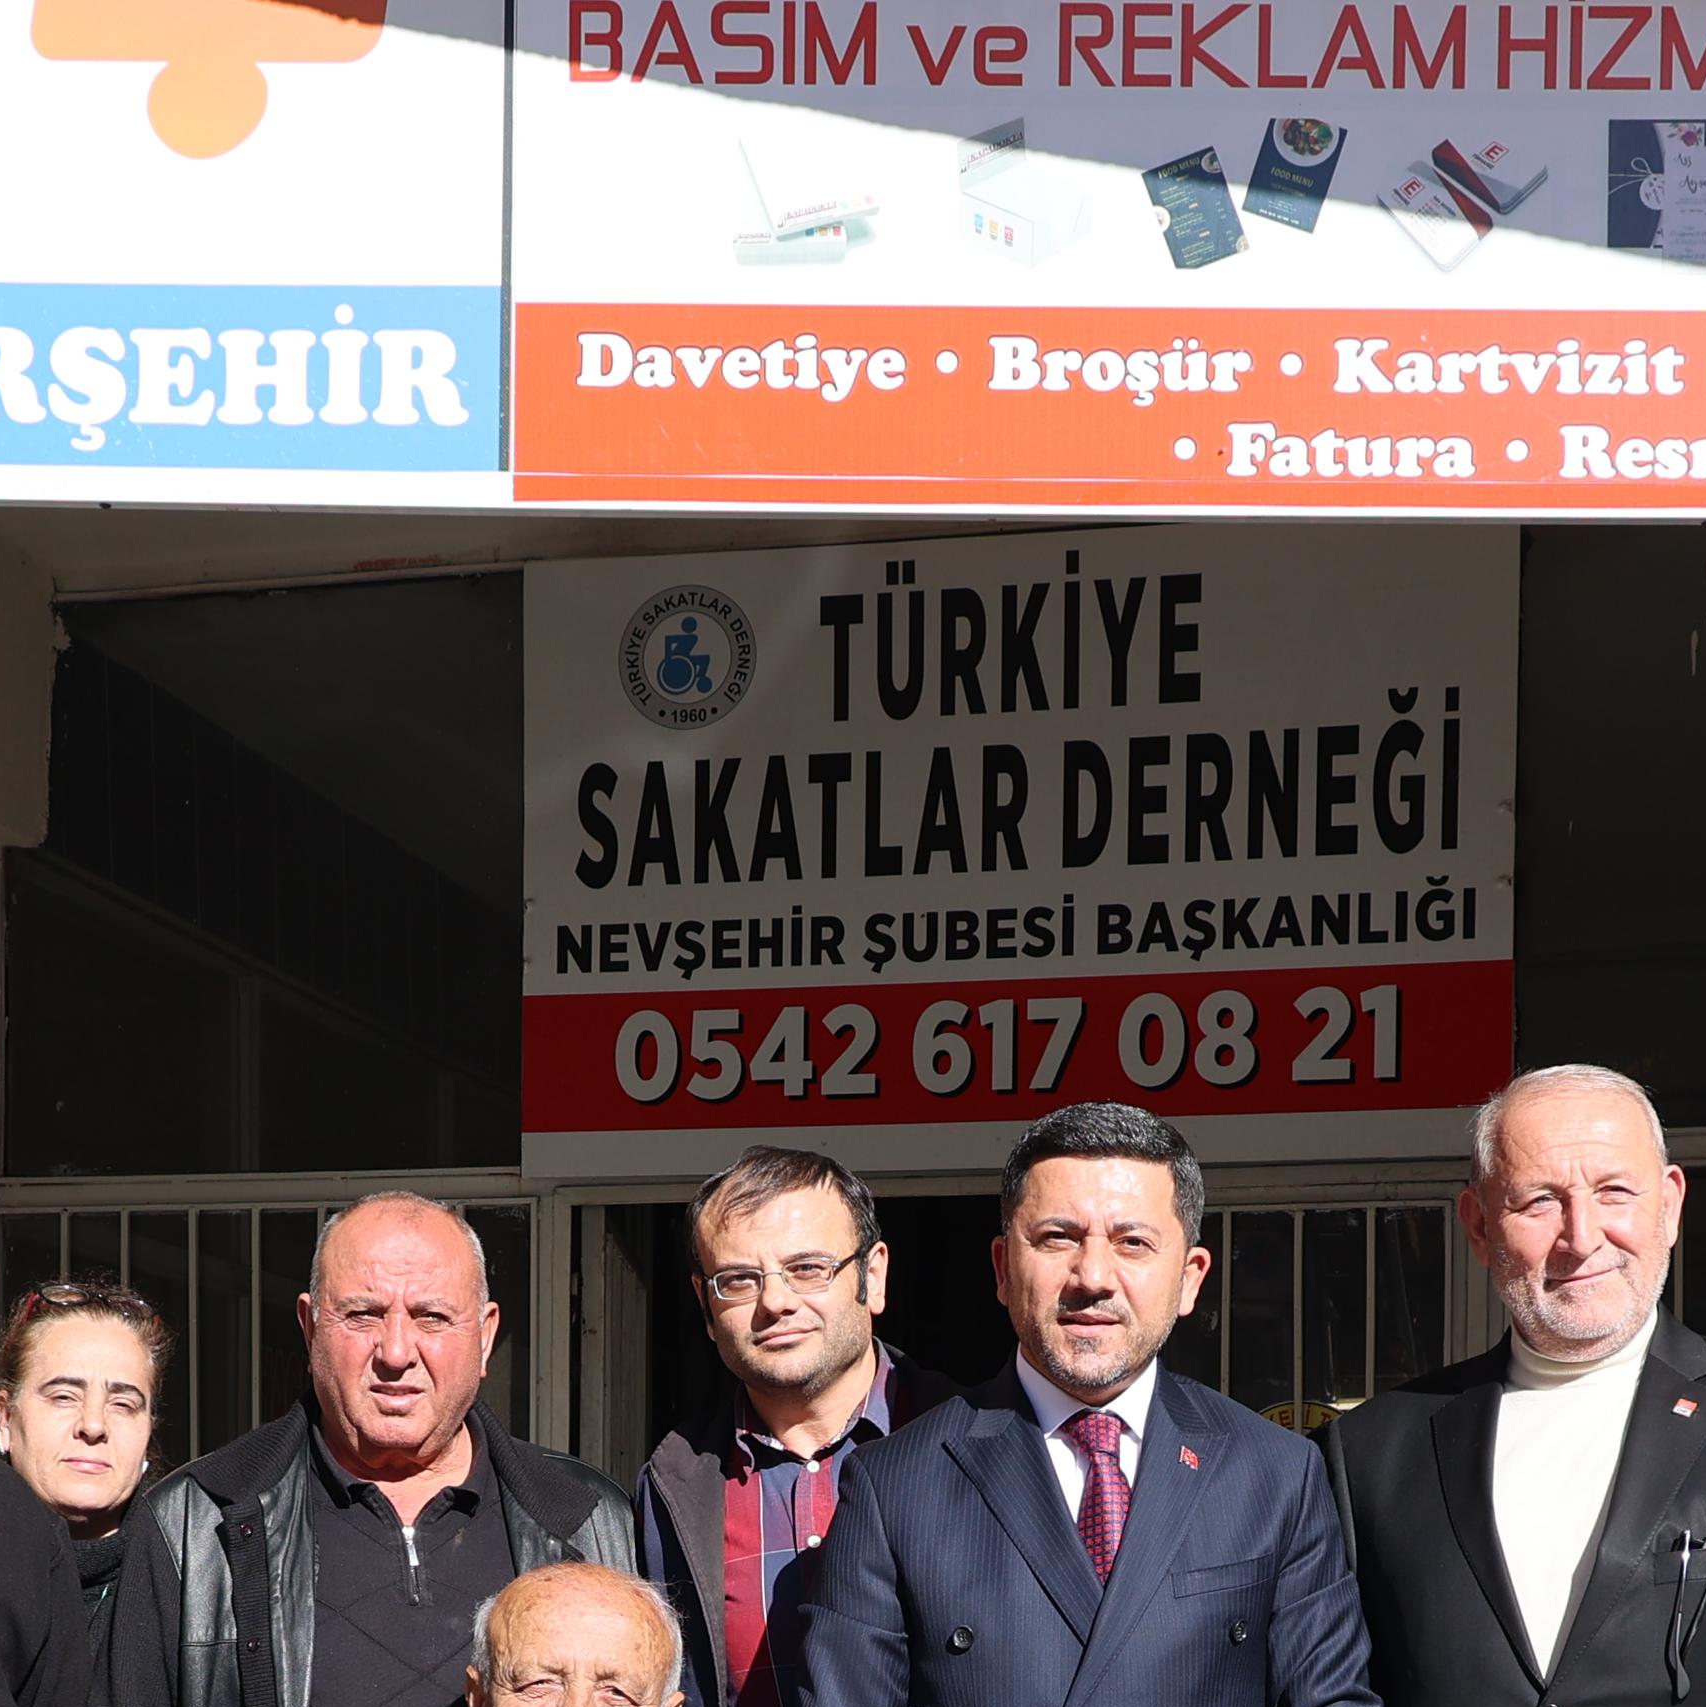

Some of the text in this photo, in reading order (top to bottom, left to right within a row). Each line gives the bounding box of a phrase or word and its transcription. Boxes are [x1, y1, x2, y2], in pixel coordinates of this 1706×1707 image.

[568, 0, 877, 86] BASIM
[907, 24, 1028, 86] ve
[1058, 3, 1466, 89] REKLAM
[576, 332, 907, 402] Davetiye
[988, 335, 1252, 407] Broşür
[1334, 338, 1685, 395] Kartvizit
[1227, 421, 1475, 478] Fatura
[643, 592, 732, 626] SAKATLAR
[821, 550, 1203, 723] TÜRKİYE
[671, 708, 707, 723] 1960
[574, 686, 1461, 889] SAKATLAR DERNEĞİ
[556, 876, 1477, 980] NEVŞEHİR ŞUBESİ BAŞKANLIĞI
[615, 983, 1402, 1104] 0542 617 08 21
